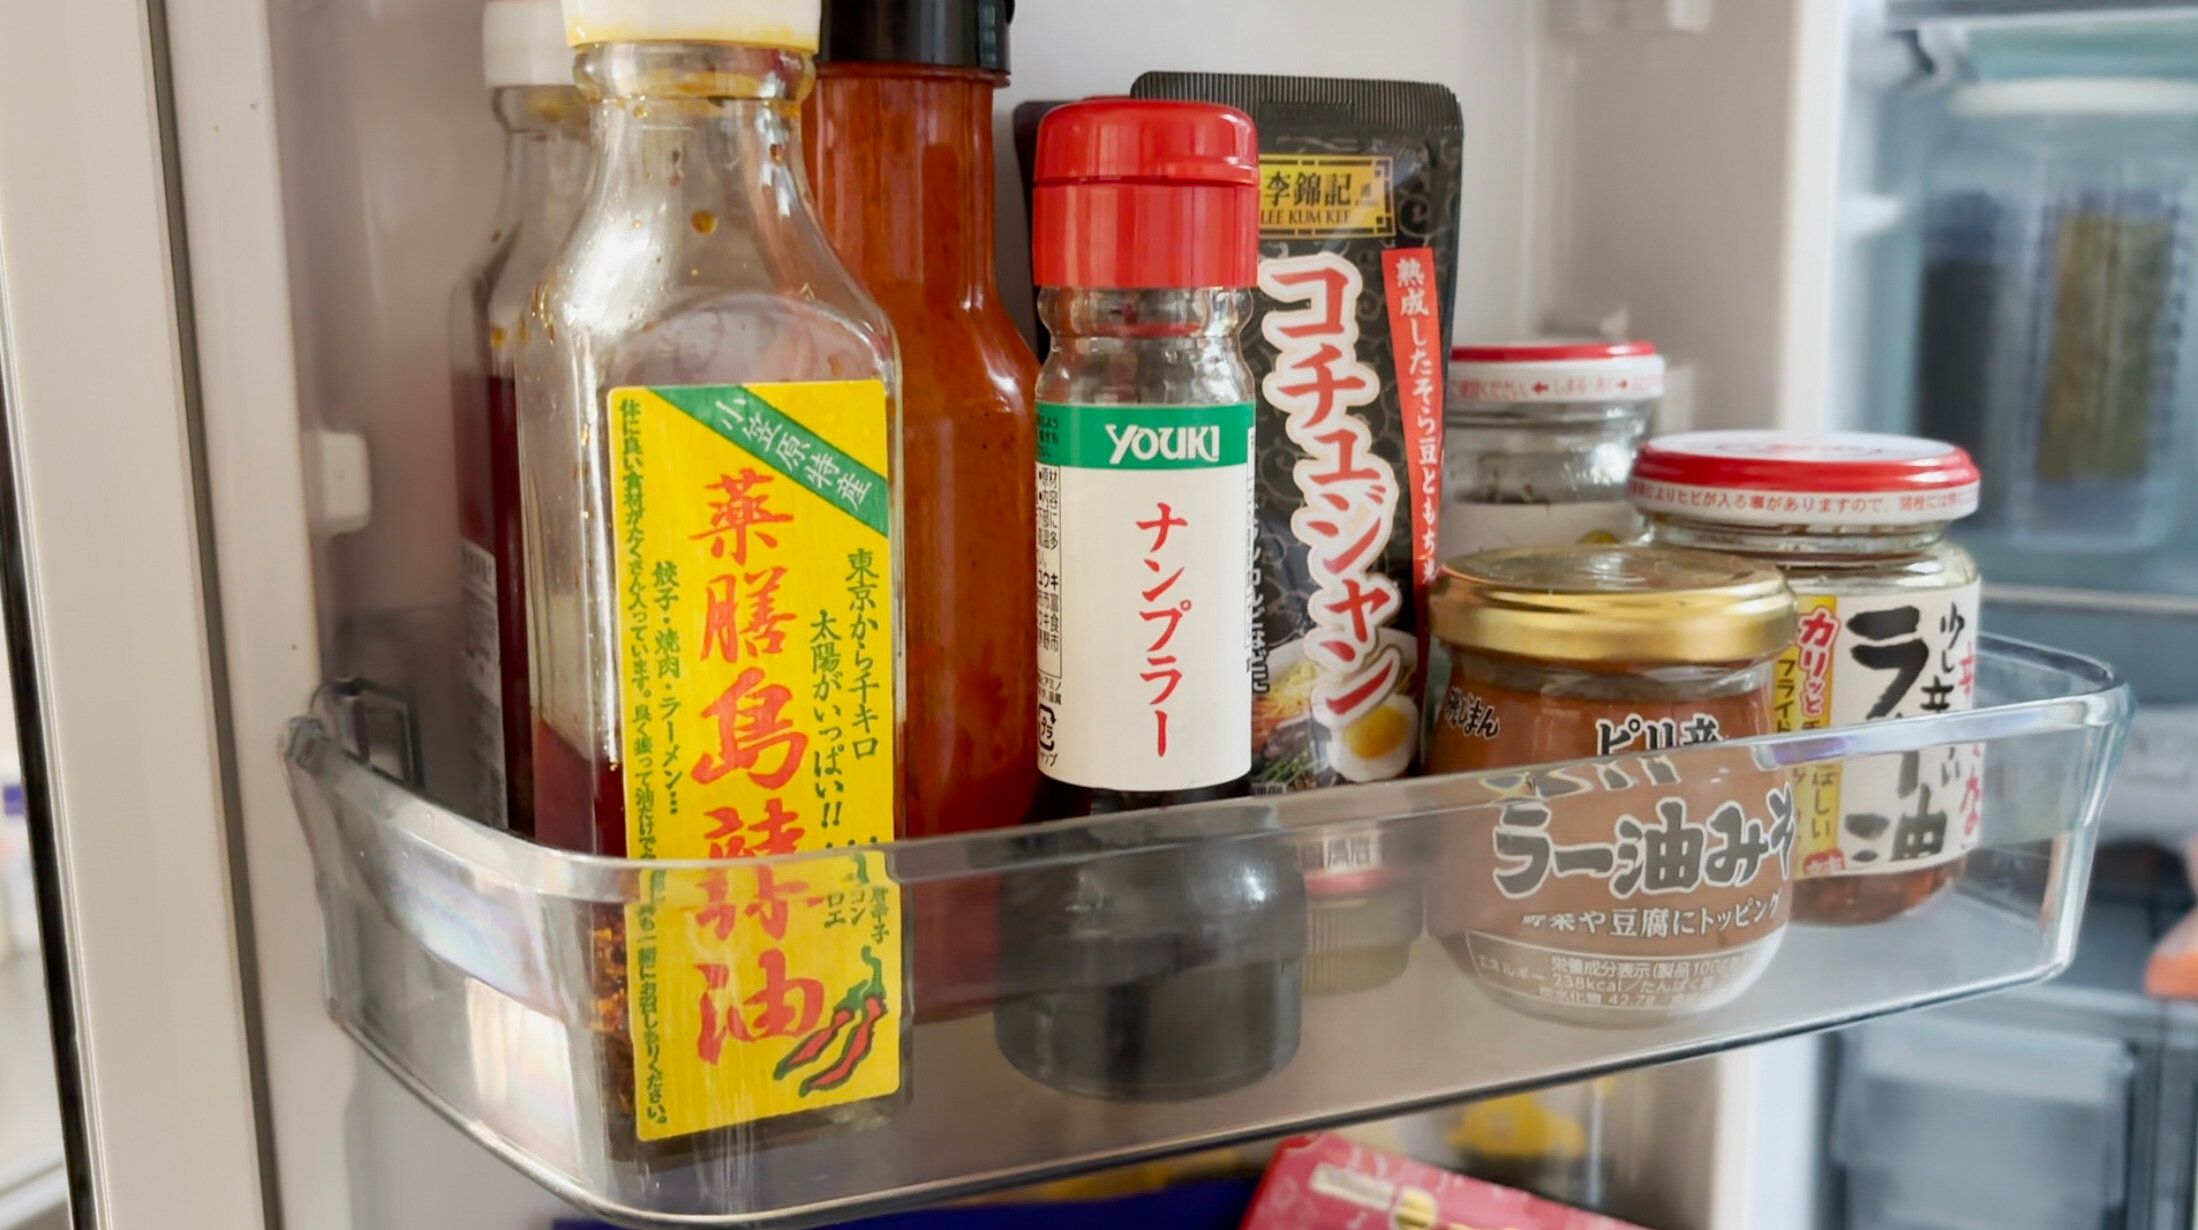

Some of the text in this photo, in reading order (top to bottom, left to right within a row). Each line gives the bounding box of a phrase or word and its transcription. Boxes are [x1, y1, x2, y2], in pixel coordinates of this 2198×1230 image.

[1263, 171, 1352, 206] 李錦記
[1288, 209, 1320, 224] KUM
[715, 396, 873, 511] 小笠原特産
[1266, 262, 1396, 720] コチュジャン
[845, 548, 881, 760] 東京から千キロ
[1135, 502, 1192, 758] ナンプラー
[1493, 783, 1797, 899] ラー油みそ
